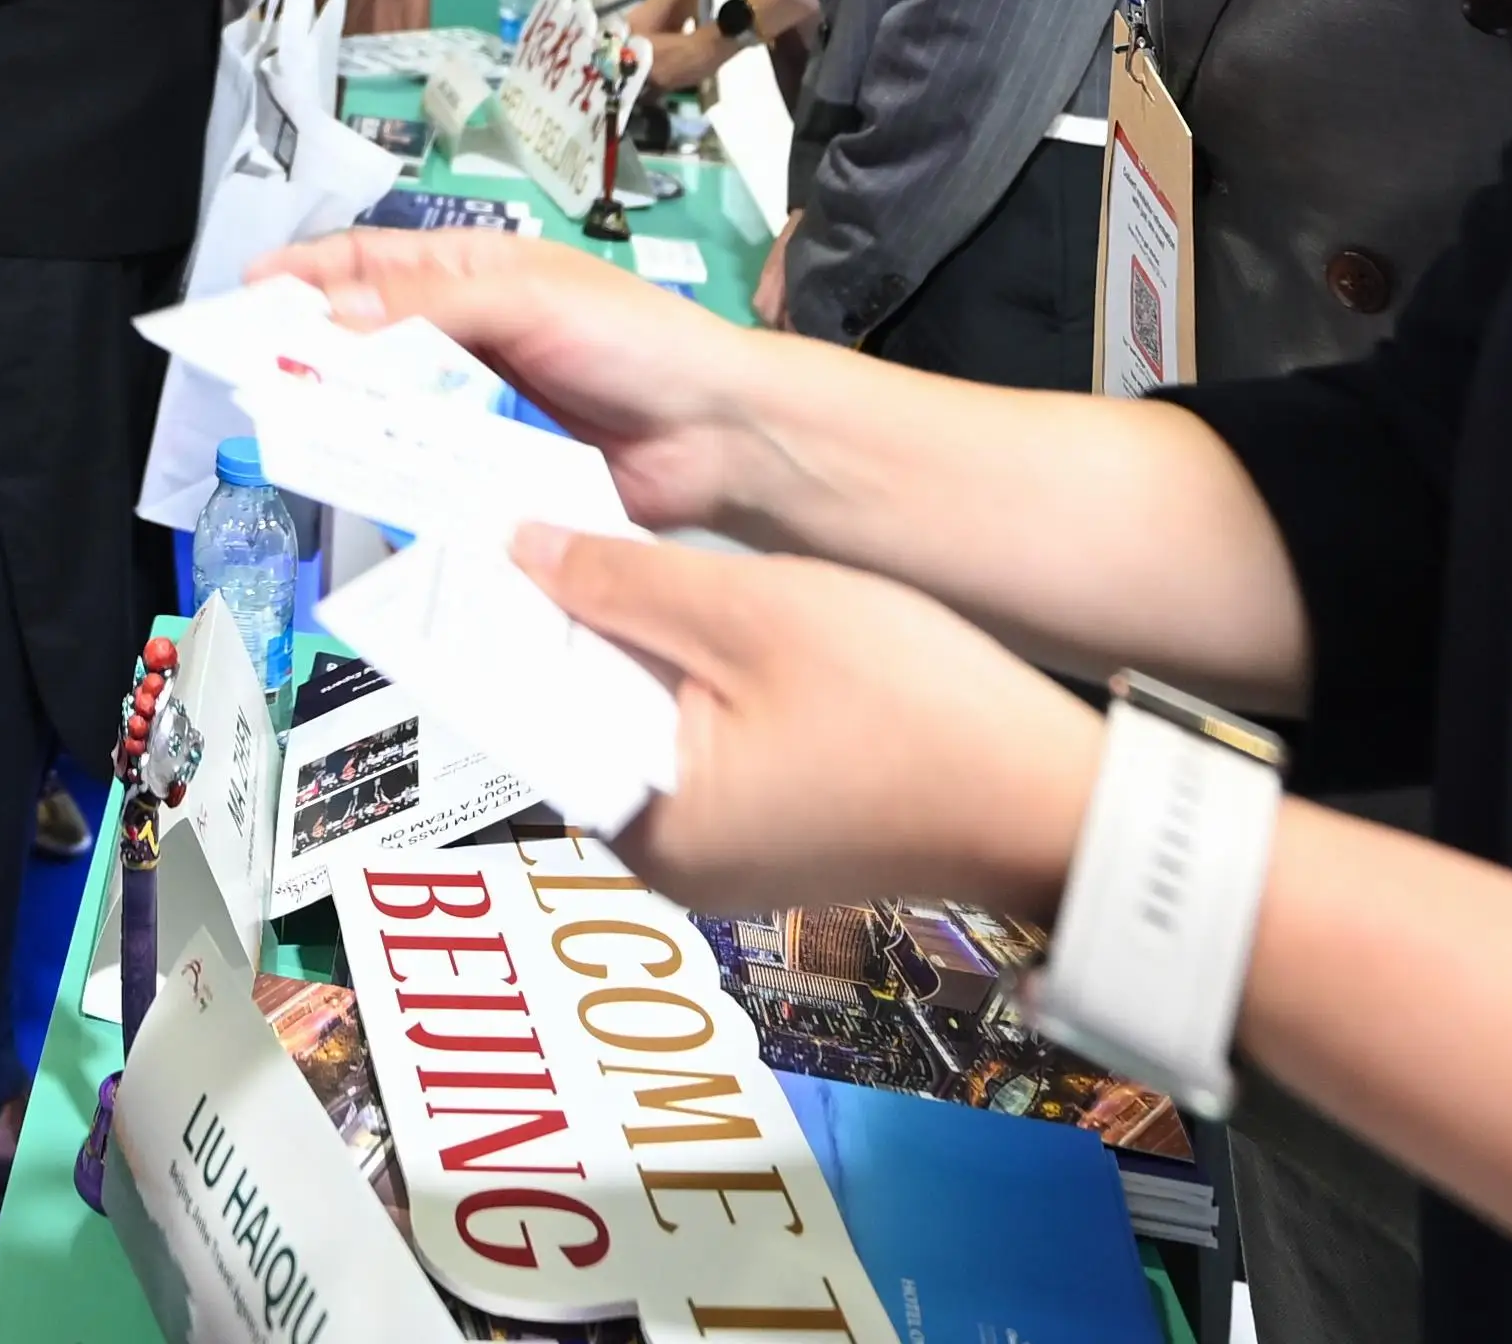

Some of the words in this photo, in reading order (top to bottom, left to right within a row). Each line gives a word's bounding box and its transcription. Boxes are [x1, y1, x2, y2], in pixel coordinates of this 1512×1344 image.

[227, 778, 247, 838] MA
[406, 821, 449, 845] PASS
[408, 807, 454, 832] TEAM
[452, 804, 489, 825] ATM
[507, 820, 804, 1235] ELCOME
[363, 868, 610, 1269] BEIJING
[182, 1093, 235, 1191] LIU
[222, 1166, 329, 1344] HAIQIU
